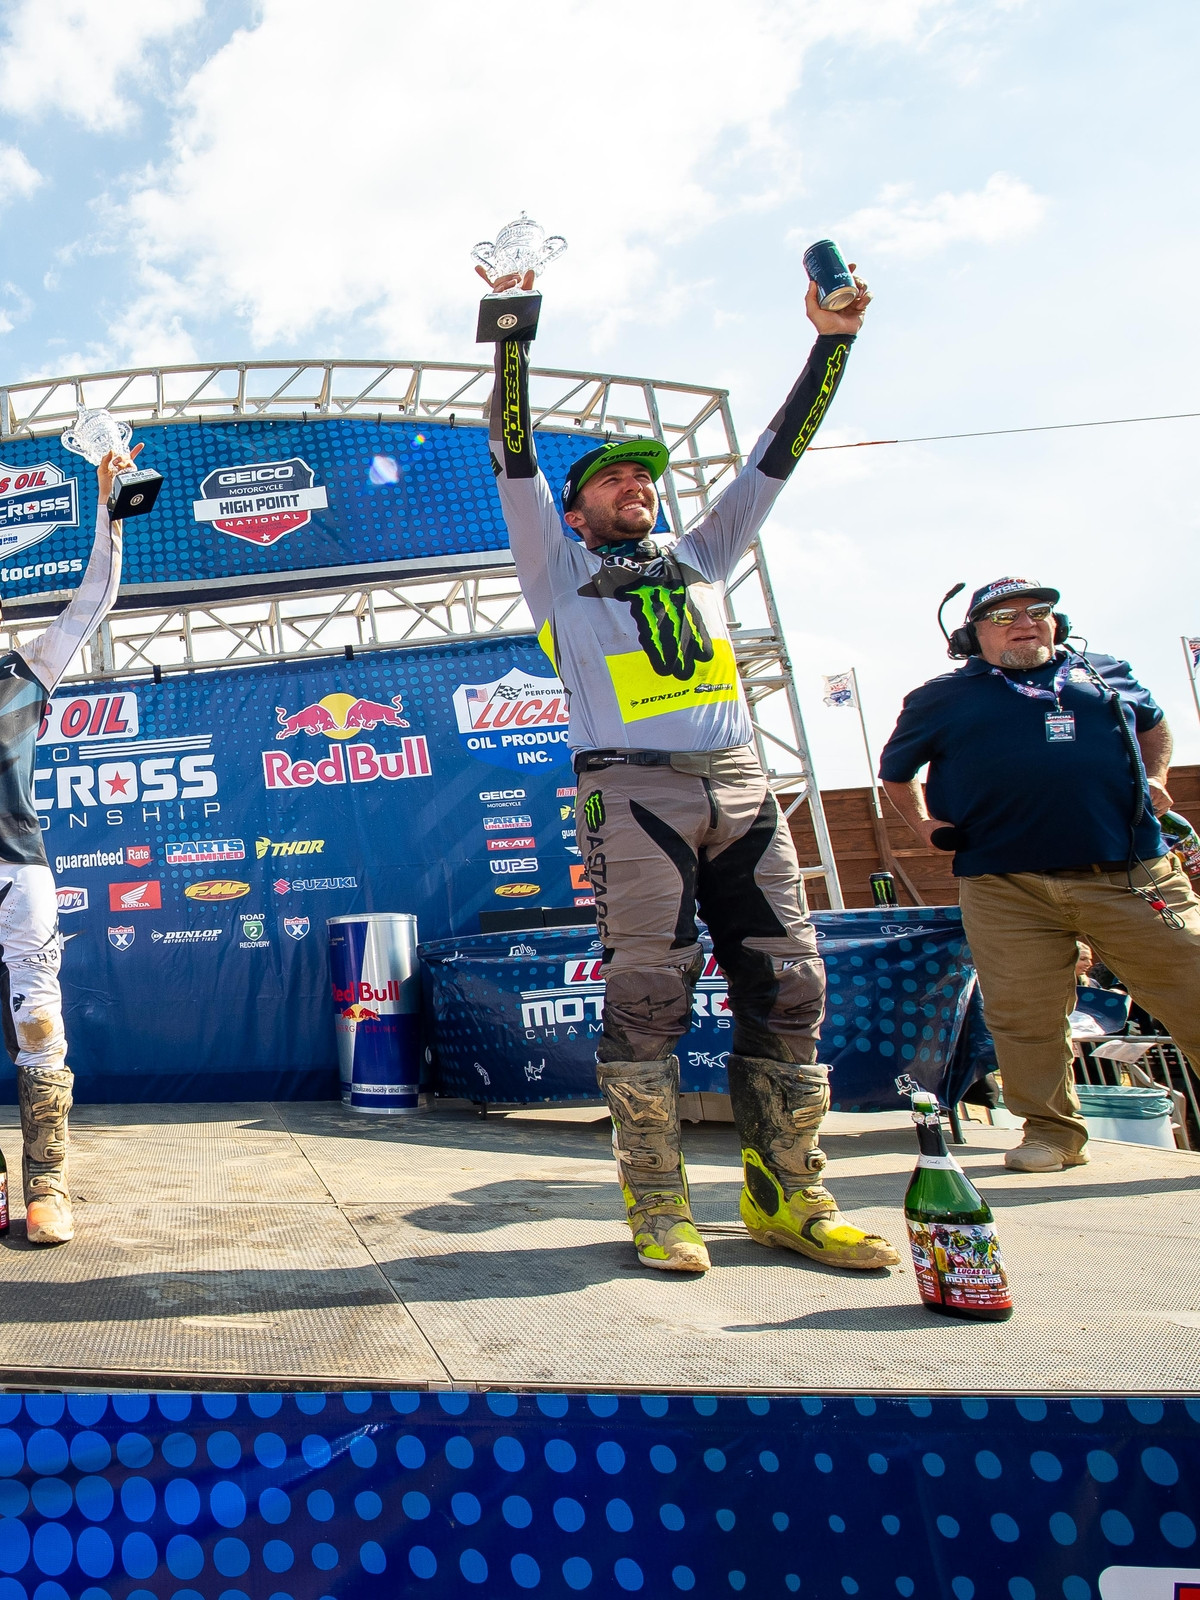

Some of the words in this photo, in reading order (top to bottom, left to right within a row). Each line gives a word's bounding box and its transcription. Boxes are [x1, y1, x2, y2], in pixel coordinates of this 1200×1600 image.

[600, 450, 661, 463] Kawasaki
[14, 471, 47, 490] OIL
[218, 466, 293, 485] GEICO
[229, 484, 284, 495] MOTORCYCLE
[219, 499, 251, 515] HIGH
[256, 494, 299, 512] POINT
[225, 513, 299, 527] NATIONAL
[525, 688, 563, 696] PERFORM
[640, 689, 690, 705] DUNLOP
[61, 692, 130, 741] OIL
[467, 737, 496, 750] OIL
[502, 730, 569, 747] PRODUC
[262, 743, 347, 789] Red
[347, 735, 432, 784] Bull
[517, 751, 553, 765] INC.
[479, 790, 526, 801] GEICO
[484, 816, 531, 825] PARTS
[166, 839, 243, 855] PARTS
[272, 839, 325, 856] THOR
[55, 848, 124, 873] guaranteed
[128, 848, 149, 860] Rate
[167, 851, 245, 864] UNLIMITED
[490, 858, 538, 874] WPS
[185, 883, 249, 897] FMF
[291, 877, 357, 891] SUZUKI
[495, 884, 540, 896] FMF
[57, 892, 82, 907] 00%
[576, 898, 596, 906] GAS
[165, 929, 222, 940] DUNLOP
[250, 926, 258, 938] 2
[291, 925, 304, 936] X
[115, 934, 129, 946] X
[240, 940, 270, 949] RECOVERY
[359, 981, 400, 1002] Bull
[945, 1275, 1002, 1285] MOTOCROSS
